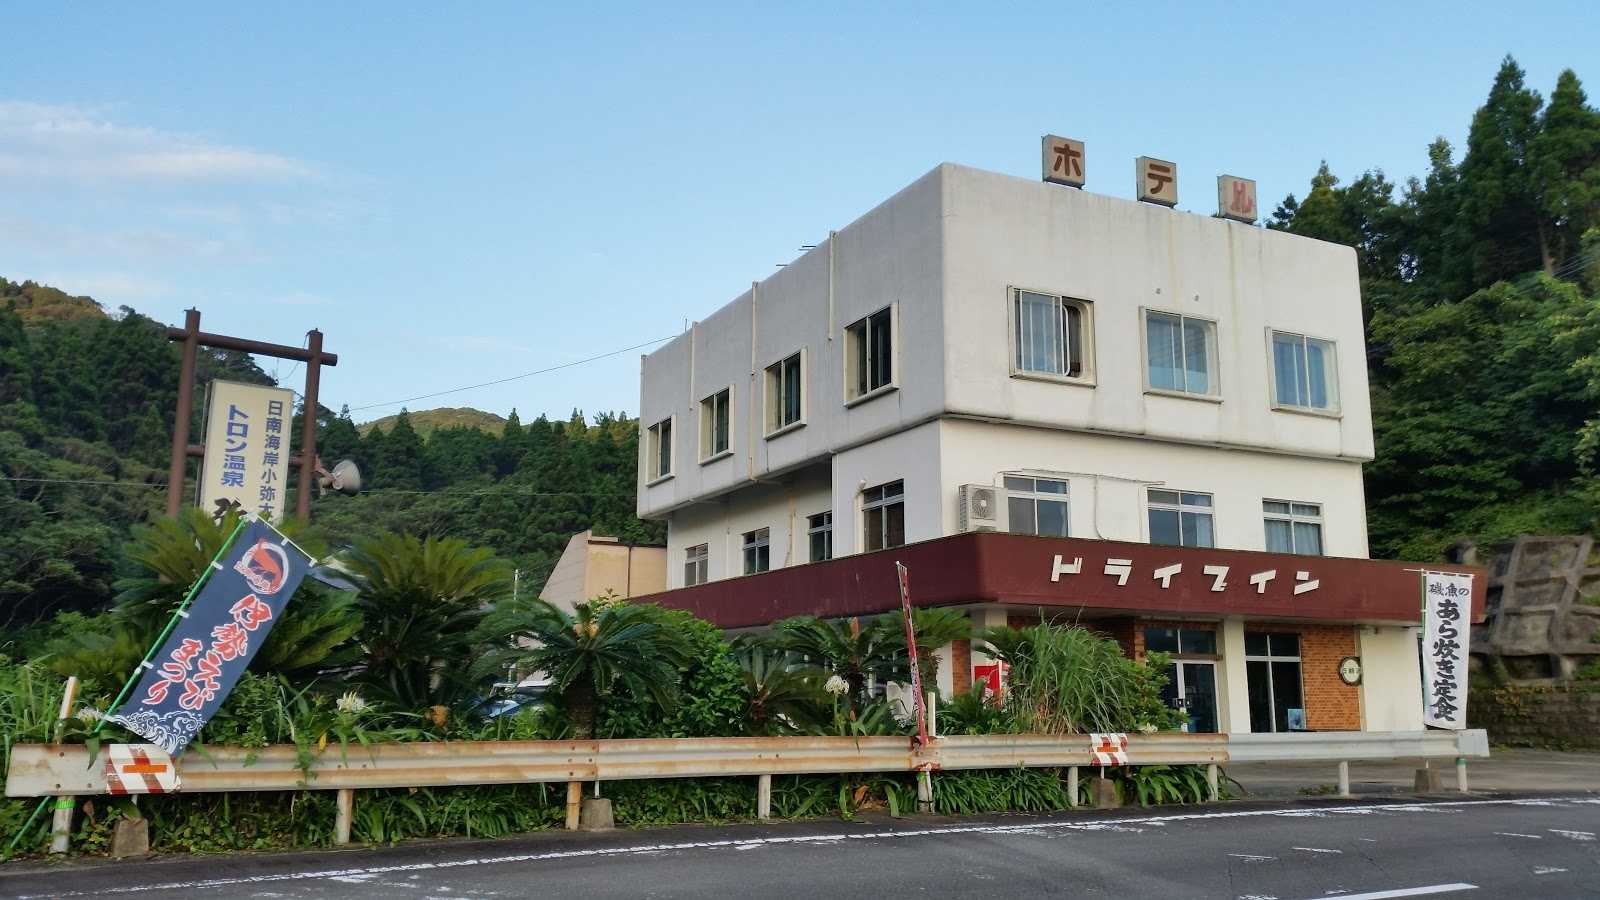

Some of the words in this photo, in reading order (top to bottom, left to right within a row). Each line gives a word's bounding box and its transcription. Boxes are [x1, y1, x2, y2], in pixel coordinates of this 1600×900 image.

[221, 404, 249, 488] トロン温泉
[1428, 582, 1470, 597] 磯魚の
[142, 639, 203, 705] まつり
[179, 594, 272, 710] 伊勢えび
[1430, 598, 1460, 721] あら炊き定食
